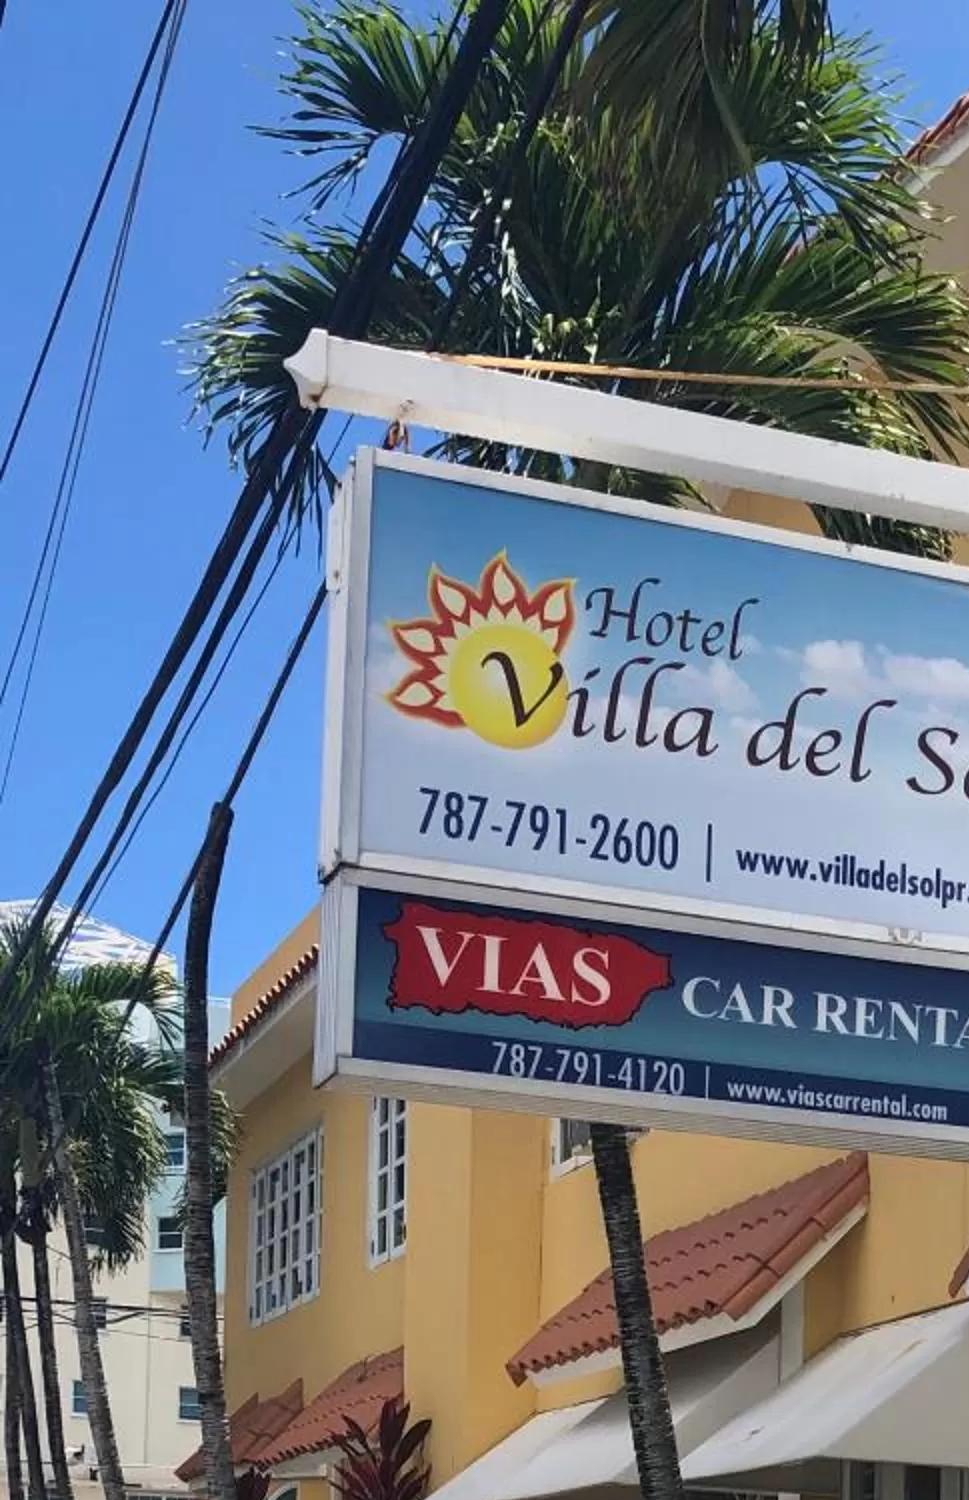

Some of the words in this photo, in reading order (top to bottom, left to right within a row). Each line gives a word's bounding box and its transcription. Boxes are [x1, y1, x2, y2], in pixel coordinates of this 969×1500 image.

[585, 578, 761, 660] Hotel
[480, 650, 718, 758] Villa
[745, 687, 898, 784] del
[418, 786, 680, 871] 787-791-2600
[415, 924, 612, 1007] VIAS
[681, 976, 798, 1031] CAR
[491, 1041, 686, 1097] 787-791-4120
[726, 1077, 949, 1123] www.viascarrental.com
